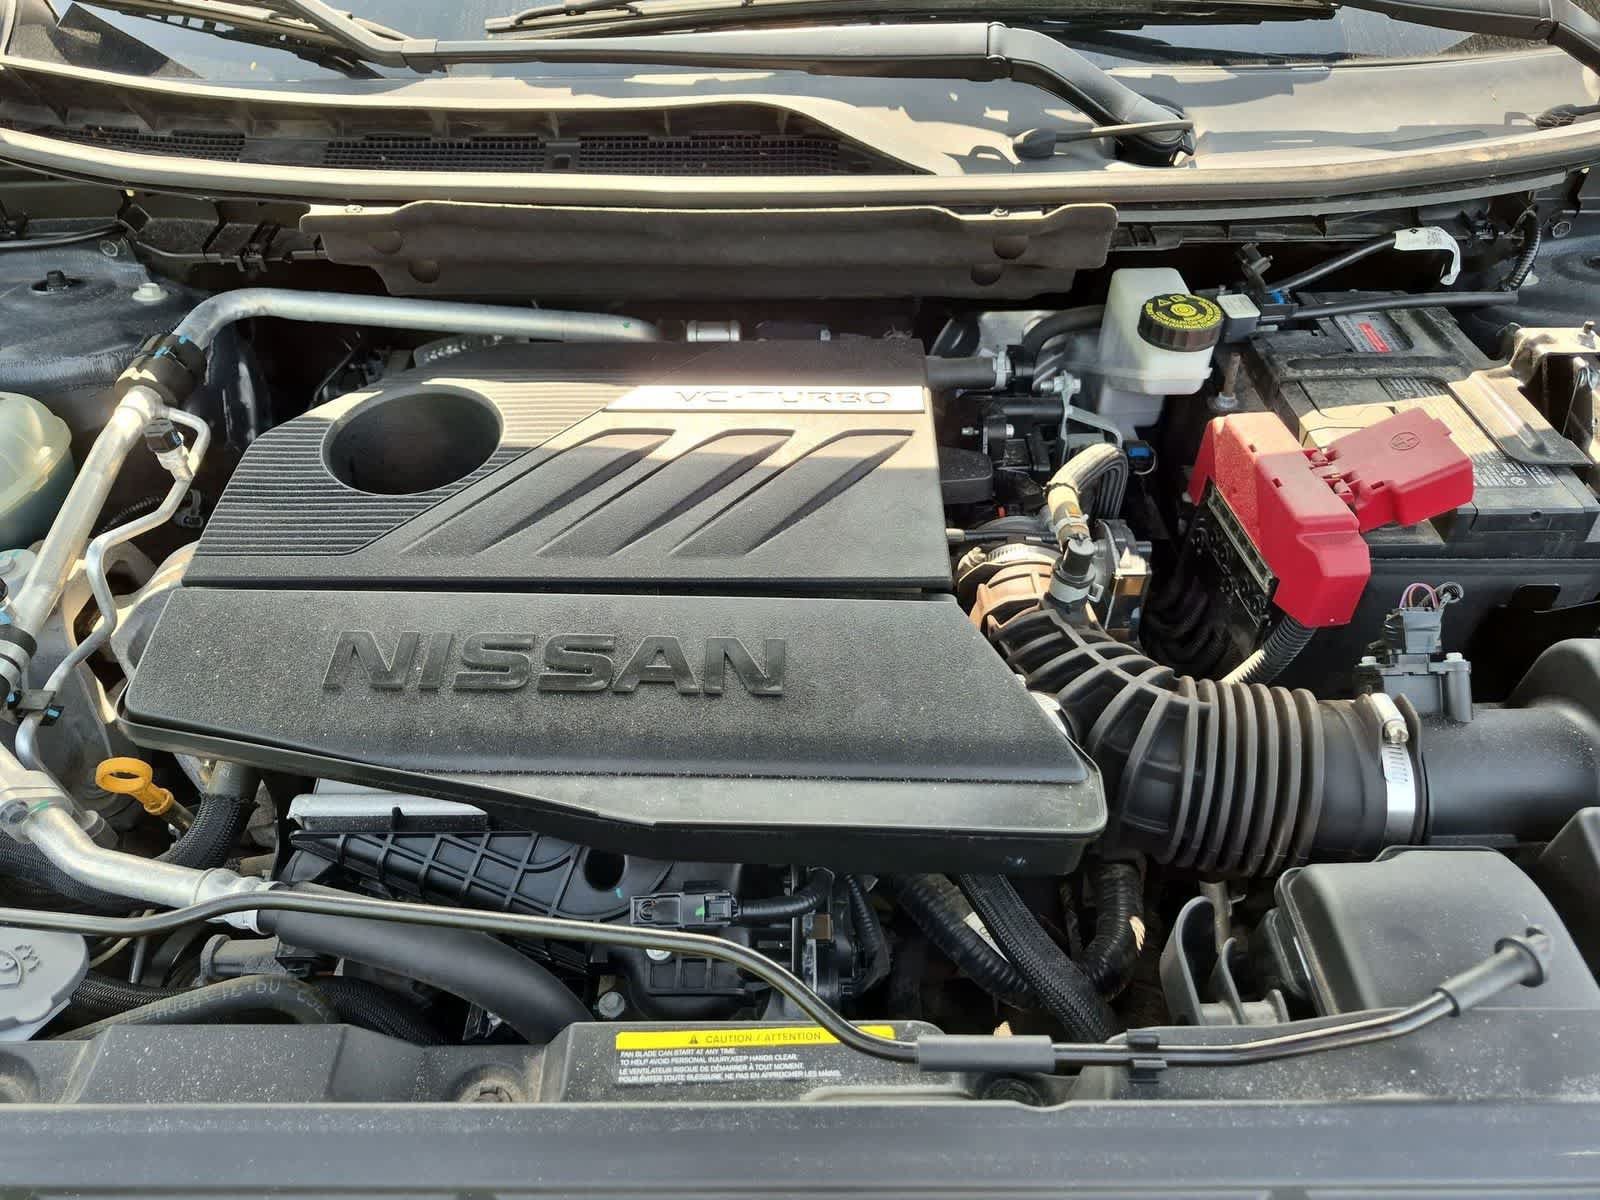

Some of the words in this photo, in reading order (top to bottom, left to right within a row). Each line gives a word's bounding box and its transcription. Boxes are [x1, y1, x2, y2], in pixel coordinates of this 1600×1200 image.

[675, 390, 892, 405] VC-TURBO
[322, 631, 786, 696] NISSAN
[705, 1034, 753, 1044] CAUTION
[764, 1031, 821, 1041] ATTENTION
[635, 1050, 657, 1058] BLADE
[658, 1049, 673, 1057] CAN
[673, 1048, 694, 1056] START
[671, 1056, 706, 1065] PERSONAL
[749, 1054, 773, 1062] HANDS
[629, 1066, 672, 1075] VENTILATEUR
[748, 1062, 755, 1070] À
[755, 1063, 772, 1071] TOUT
[664, 1074, 686, 1082] TOUTE
[724, 1072, 735, 1080] NE
[735, 1072, 749, 1080] PAS
[750, 1071, 760, 1079] EN
